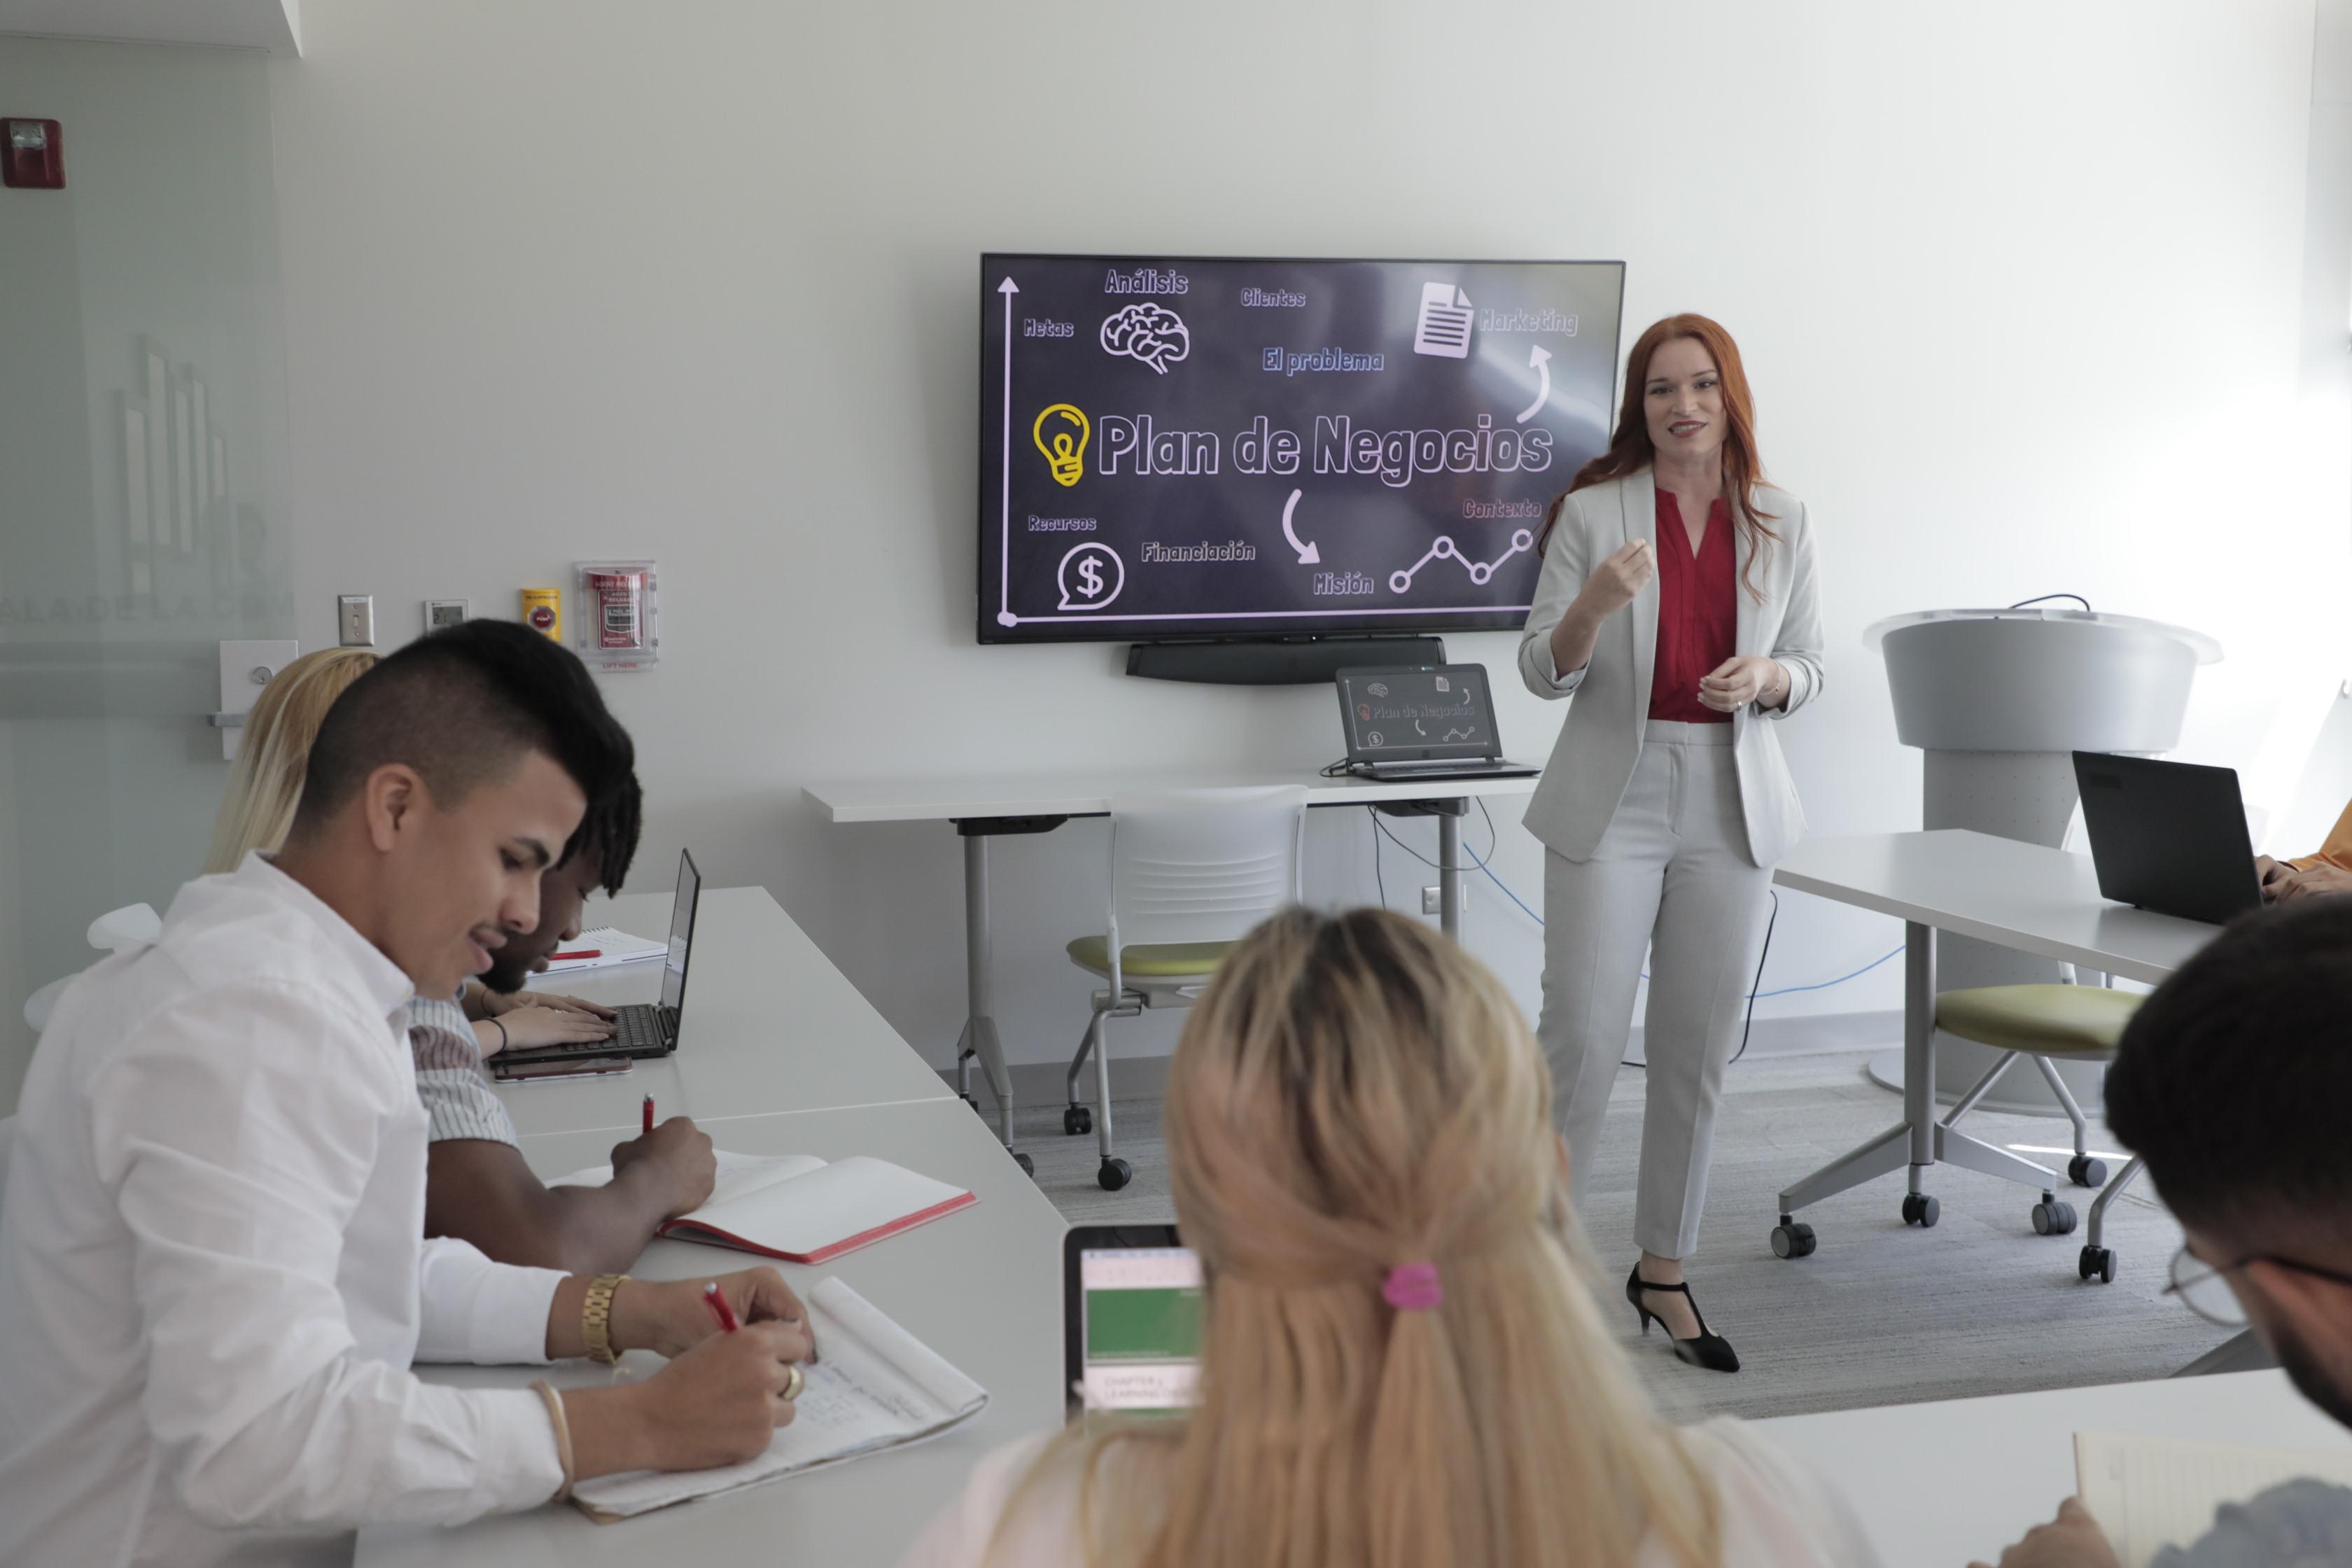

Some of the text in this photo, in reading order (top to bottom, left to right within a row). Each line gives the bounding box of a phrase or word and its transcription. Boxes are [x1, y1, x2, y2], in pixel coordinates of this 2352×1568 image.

[1105, 269, 1189, 294] Análisis
[1241, 288, 1306, 307] Clientes
[1023, 318, 1074, 337] Metas
[1479, 308, 1579, 337] Marketing
[1263, 347, 1384, 377] El problema
[1099, 414, 1553, 487] Plan de Negocios
[1463, 498, 1542, 518] Contexto
[1028, 515, 1096, 531] Recursos
[1142, 540, 1256, 561] Financiación
[1313, 572, 1373, 594] Misión
